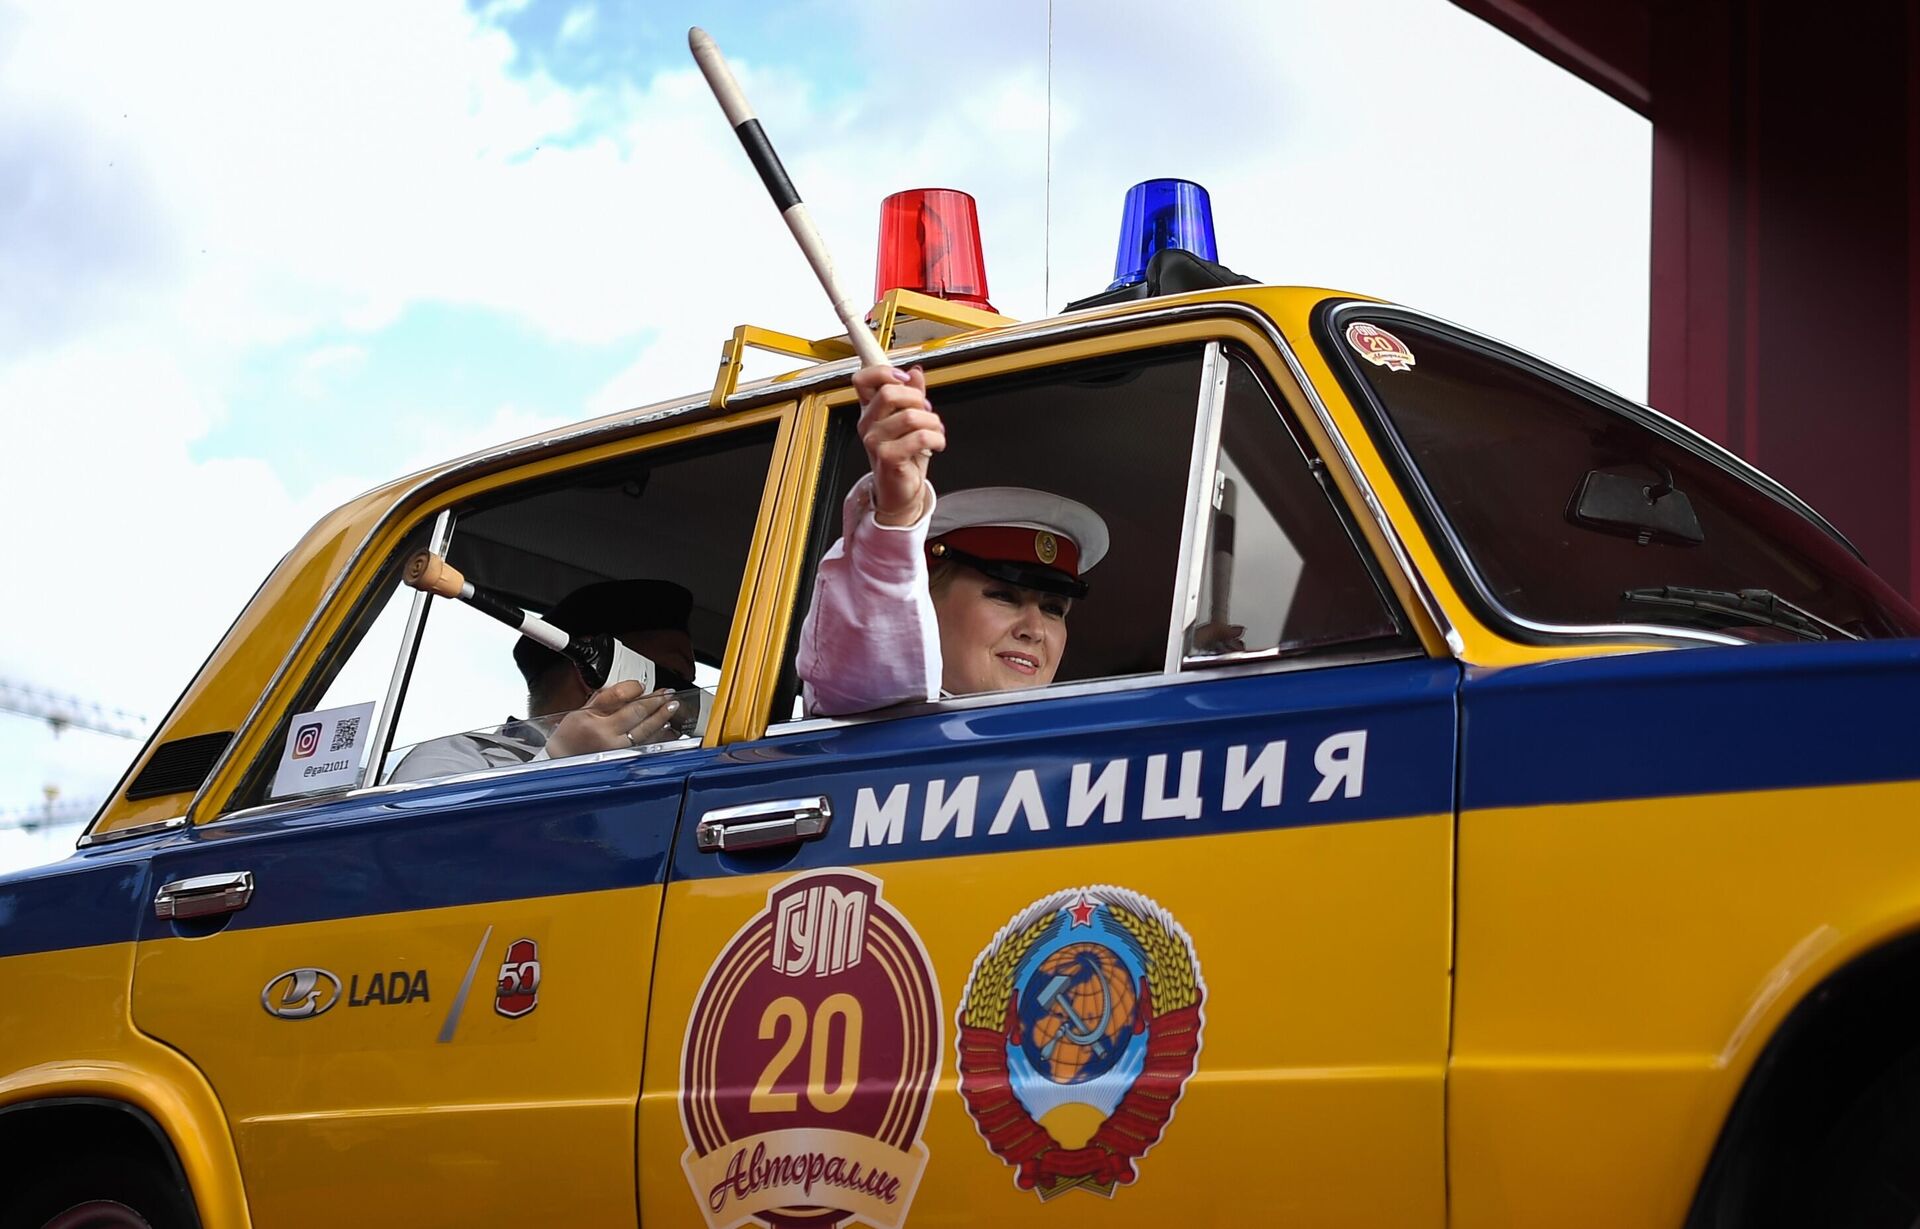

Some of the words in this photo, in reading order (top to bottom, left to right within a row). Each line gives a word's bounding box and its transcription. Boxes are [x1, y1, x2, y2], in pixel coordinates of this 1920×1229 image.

[1364, 336, 1393, 351] 20
[303, 760, 350, 778] @gai21011
[849, 729, 1367, 848] МИЛИЦИЯ
[772, 886, 868, 977] ГУМ
[348, 970, 430, 1007] LADA
[498, 961, 541, 996] 50
[749, 993, 863, 1113] 20
[709, 1141, 901, 1213] Авторалли
